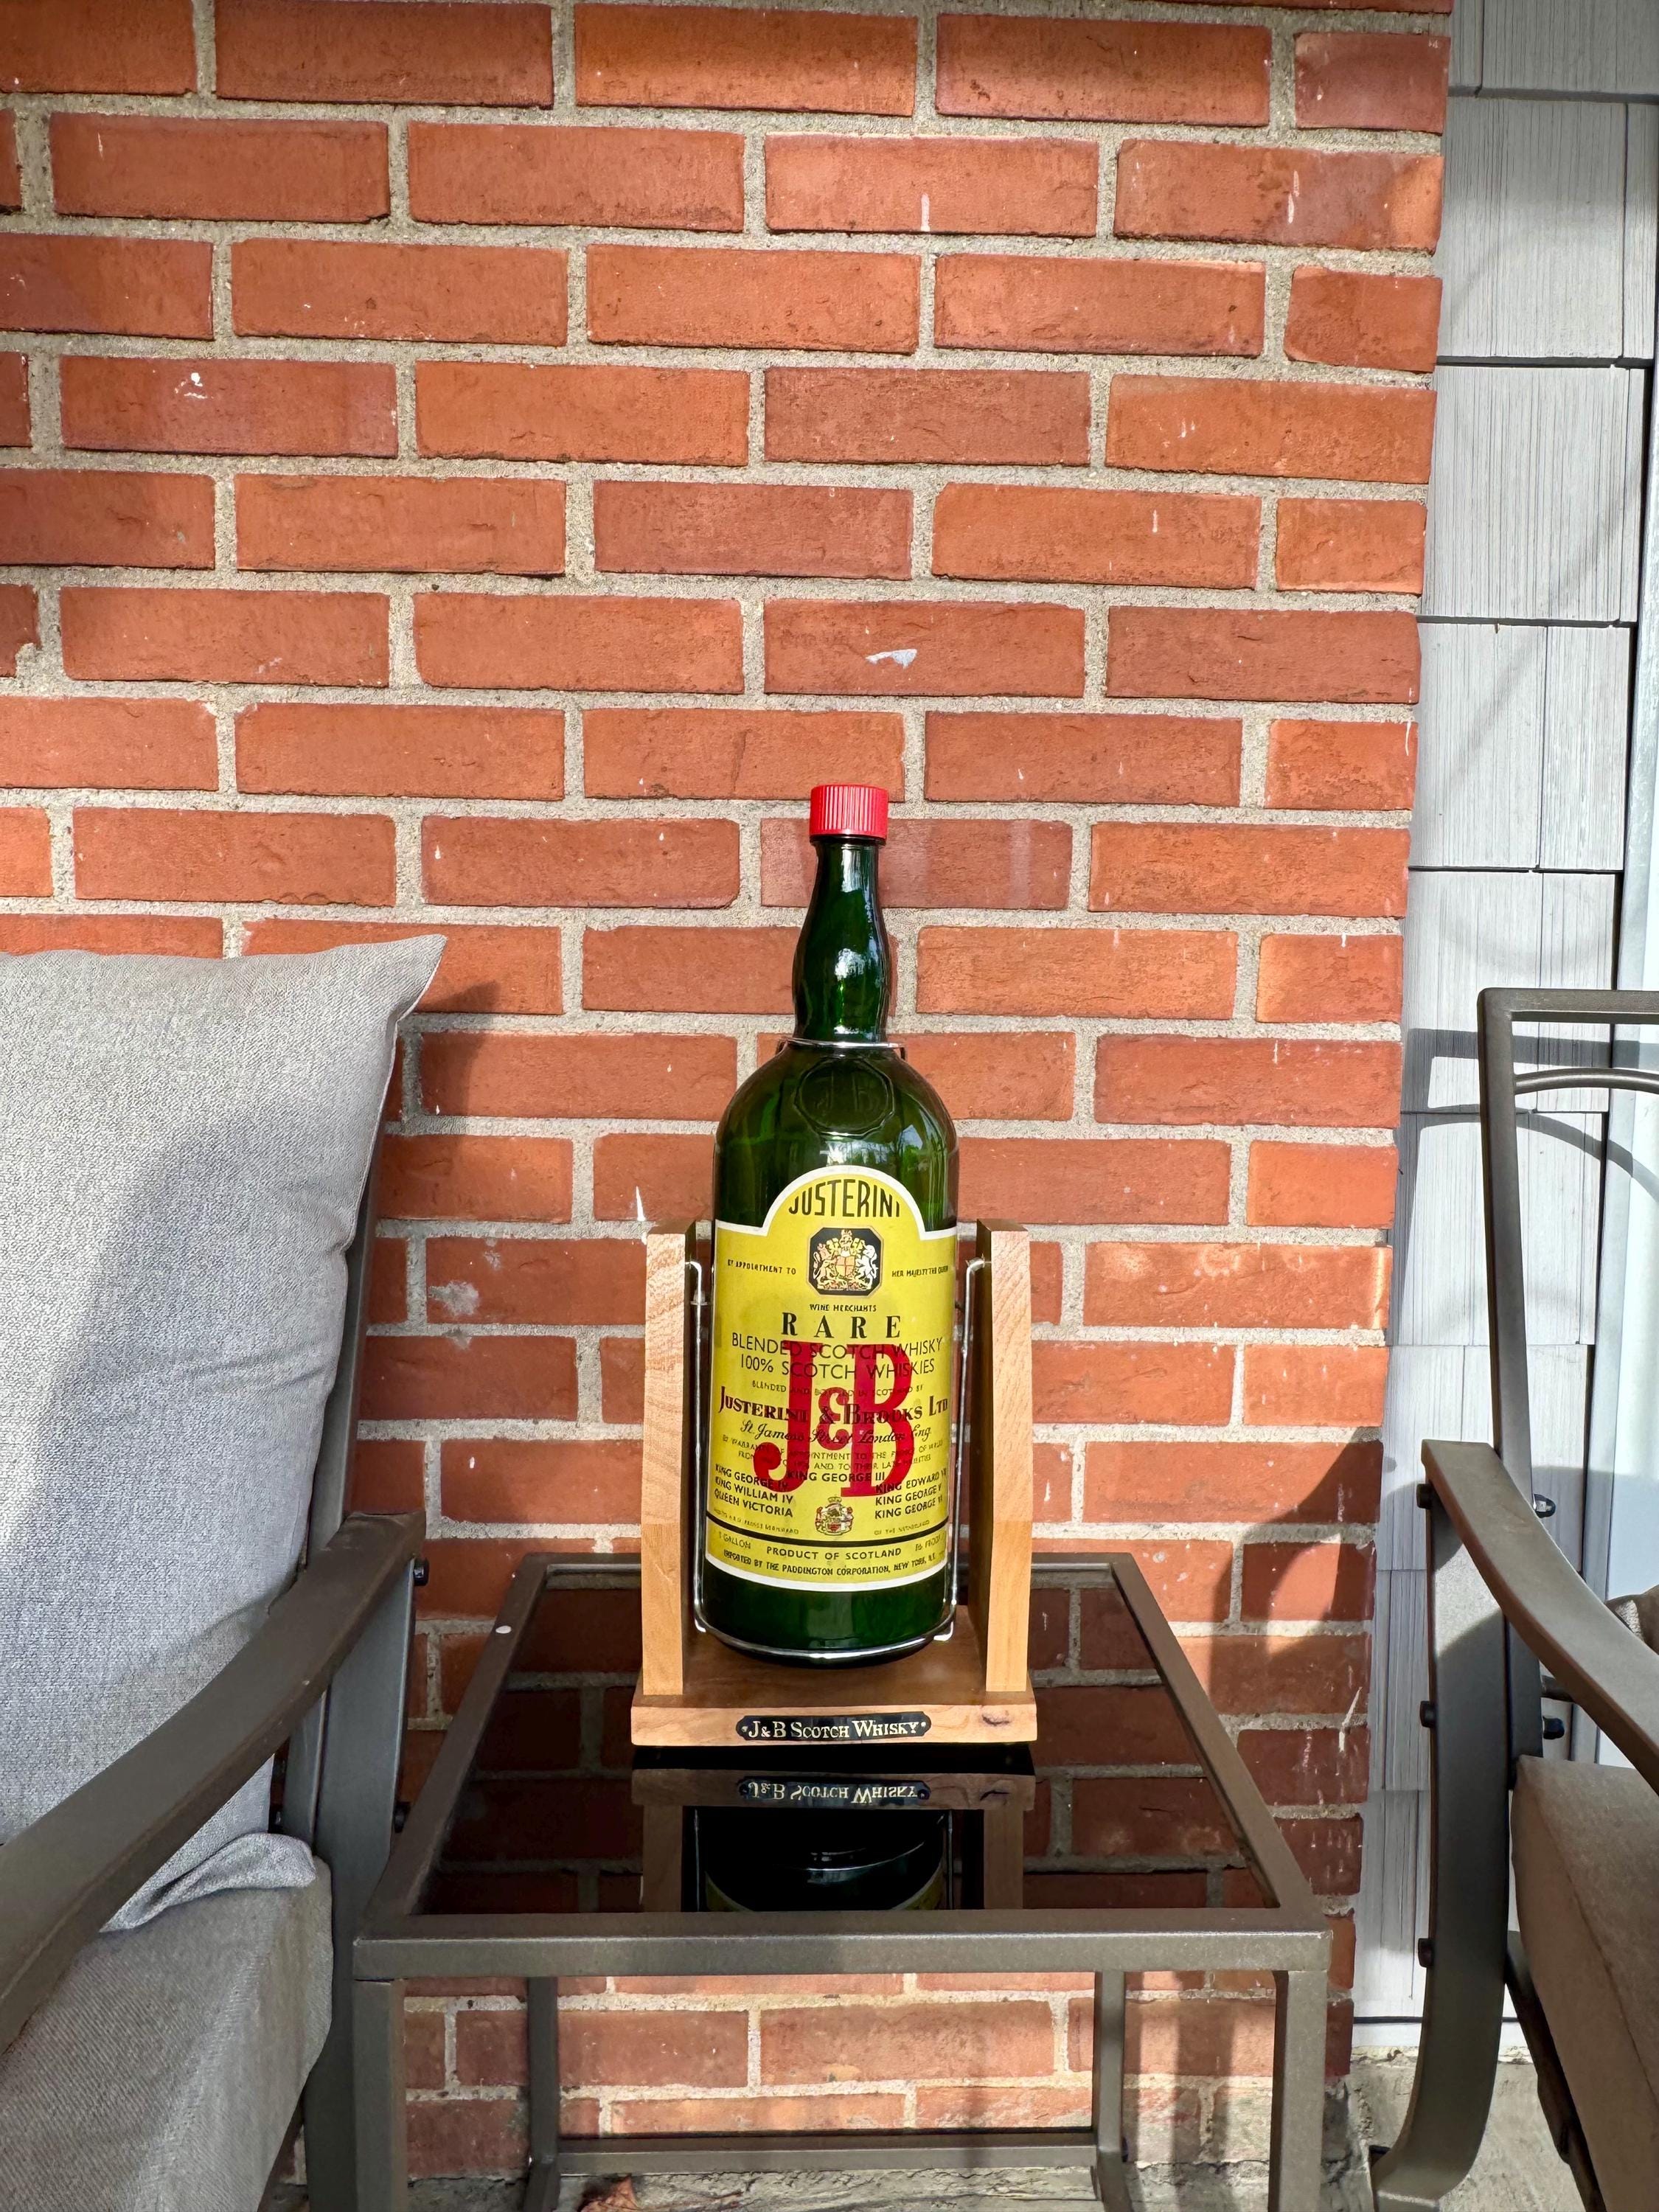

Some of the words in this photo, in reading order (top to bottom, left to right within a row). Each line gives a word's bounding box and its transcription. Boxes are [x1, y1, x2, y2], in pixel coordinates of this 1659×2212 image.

[789, 1178, 900, 1217] JUSTERINI
[787, 1267, 796, 1275] TO
[891, 1270, 904, 1278] HER
[833, 1304, 877, 1312] MERCHANTS
[781, 1312, 901, 1338] RARE
[732, 1332, 802, 1357] BLENDED
[810, 1343, 885, 1360] SCOTCH
[891, 1337, 943, 1357] WHISKY
[741, 1354, 773, 1373] 100%
[782, 1361, 856, 1379] SCOTCH
[866, 1358, 935, 1379] WHISKIES
[752, 1380, 786, 1392] BLENDED
[719, 1386, 807, 1423] JUSTERINI
[821, 1406, 835, 1424] &
[844, 1404, 923, 1425] BROOKS
[929, 1395, 948, 1416] LTD
[715, 1464, 732, 1478] KING
[734, 1471, 773, 1488] GEORGE
[787, 1471, 817, 1481] KING
[821, 1472, 872, 1482] GEORGE
[875, 1472, 885, 1481] III
[813, 1462, 833, 1470] AND
[838, 1463, 851, 1471] TO
[715, 1475, 732, 1490] KING
[734, 1483, 778, 1502] WILLIAM
[782, 1495, 793, 1505] IV
[875, 1481, 902, 1494] KING
[906, 1471, 939, 1489] EDWARD
[714, 1488, 740, 1506] QUEEN
[742, 1499, 793, 1517] VICTORIA
[875, 1495, 902, 1506] KING
[905, 1486, 936, 1502] GEORGE
[874, 1507, 902, 1520] KING
[905, 1499, 936, 1514] GEORGE
[723, 1532, 751, 1549] GALLON
[723, 1549, 751, 1565] IMPORTED
[754, 1559, 762, 1568] BY
[766, 1562, 779, 1571] THE
[782, 1565, 833, 1576] PADDINGTON
[836, 1565, 891, 1576] CORPORATION,
[894, 1561, 908, 1571] NEW
[766, 1546, 819, 1559] PRODUCT
[824, 1552, 839, 1560] OF
[845, 1548, 902, 1560] SCOTLAND
[748, 1720, 787, 1739] J&B
